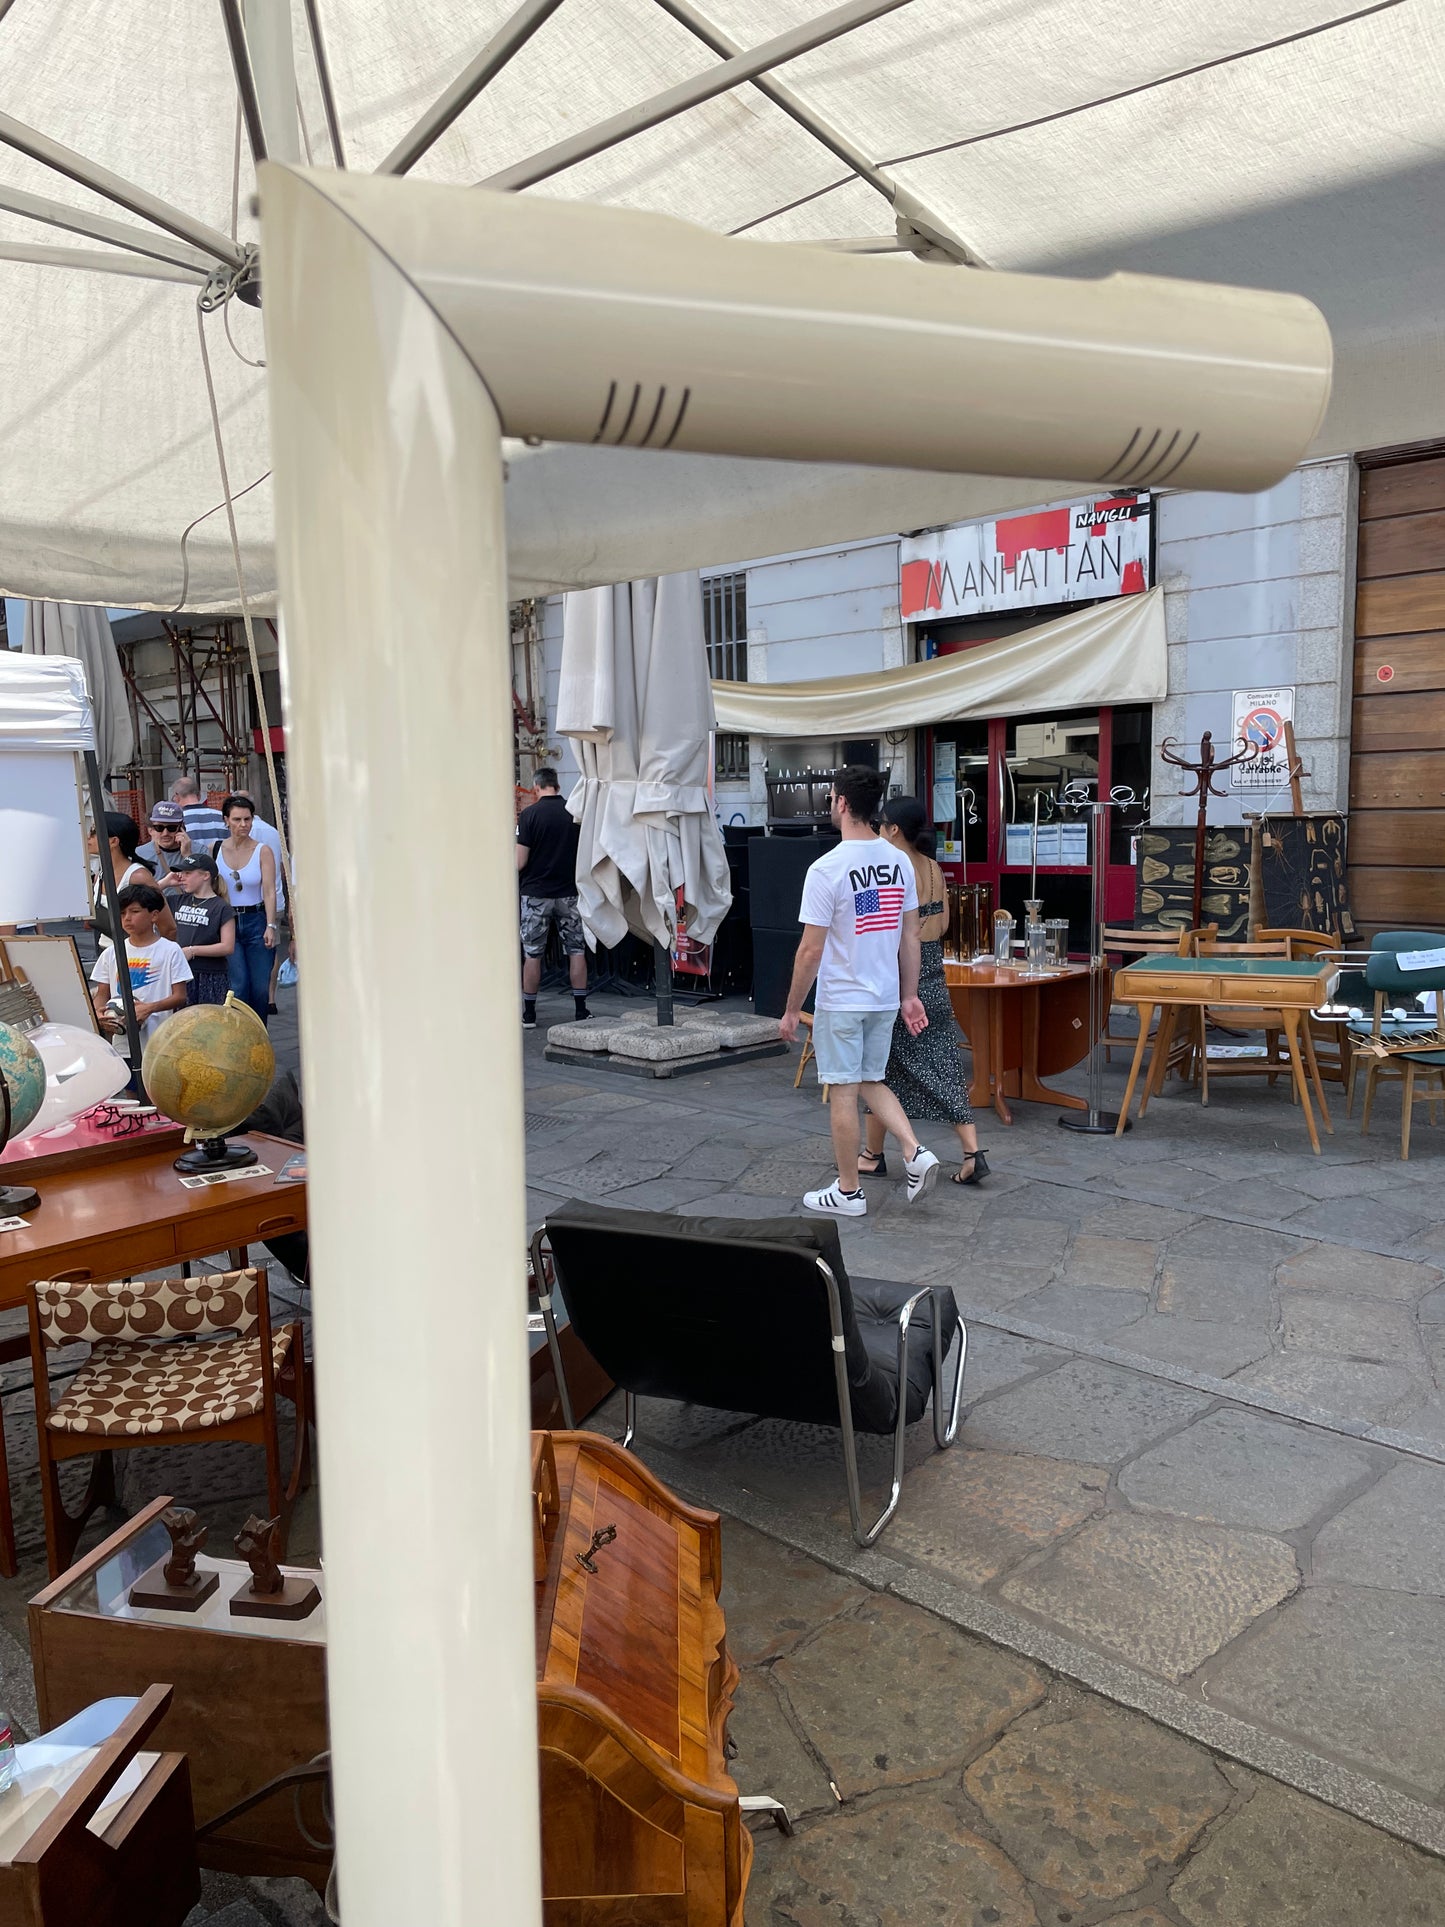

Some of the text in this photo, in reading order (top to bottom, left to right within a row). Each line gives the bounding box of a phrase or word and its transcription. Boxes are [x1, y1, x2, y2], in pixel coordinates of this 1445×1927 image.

[1077, 507, 1131, 526] NAVIGLI
[923, 535, 1121, 611] MANHATTAN
[849, 864, 905, 892] NASA
[179, 905, 208, 916] BEACH
